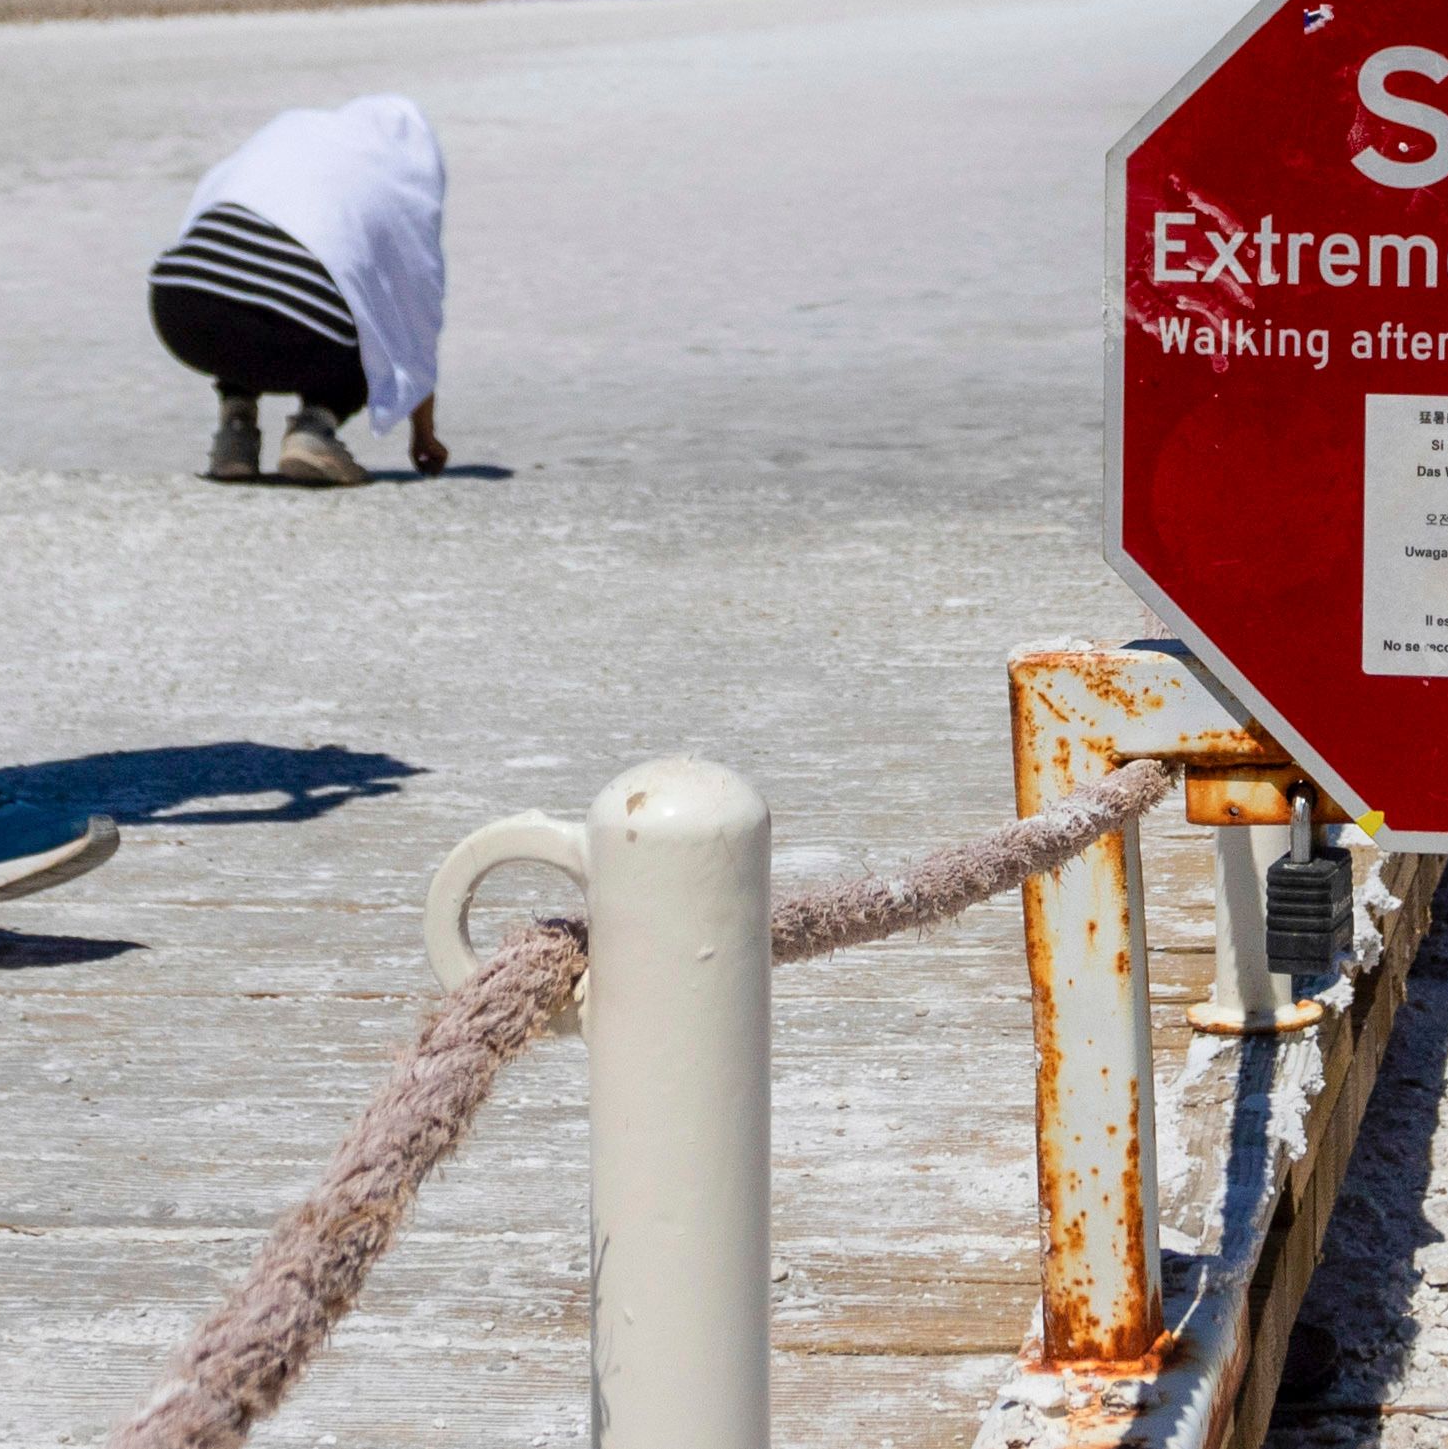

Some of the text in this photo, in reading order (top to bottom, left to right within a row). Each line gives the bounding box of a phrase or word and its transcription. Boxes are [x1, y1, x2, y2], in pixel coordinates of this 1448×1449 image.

[1158, 316, 1330, 370] Walking
[1432, 439, 1444, 451] Si
[1417, 465, 1441, 477] Das
[1426, 615, 1433, 626] Il
[1384, 640, 1401, 651] No
[1405, 643, 1420, 652] se
